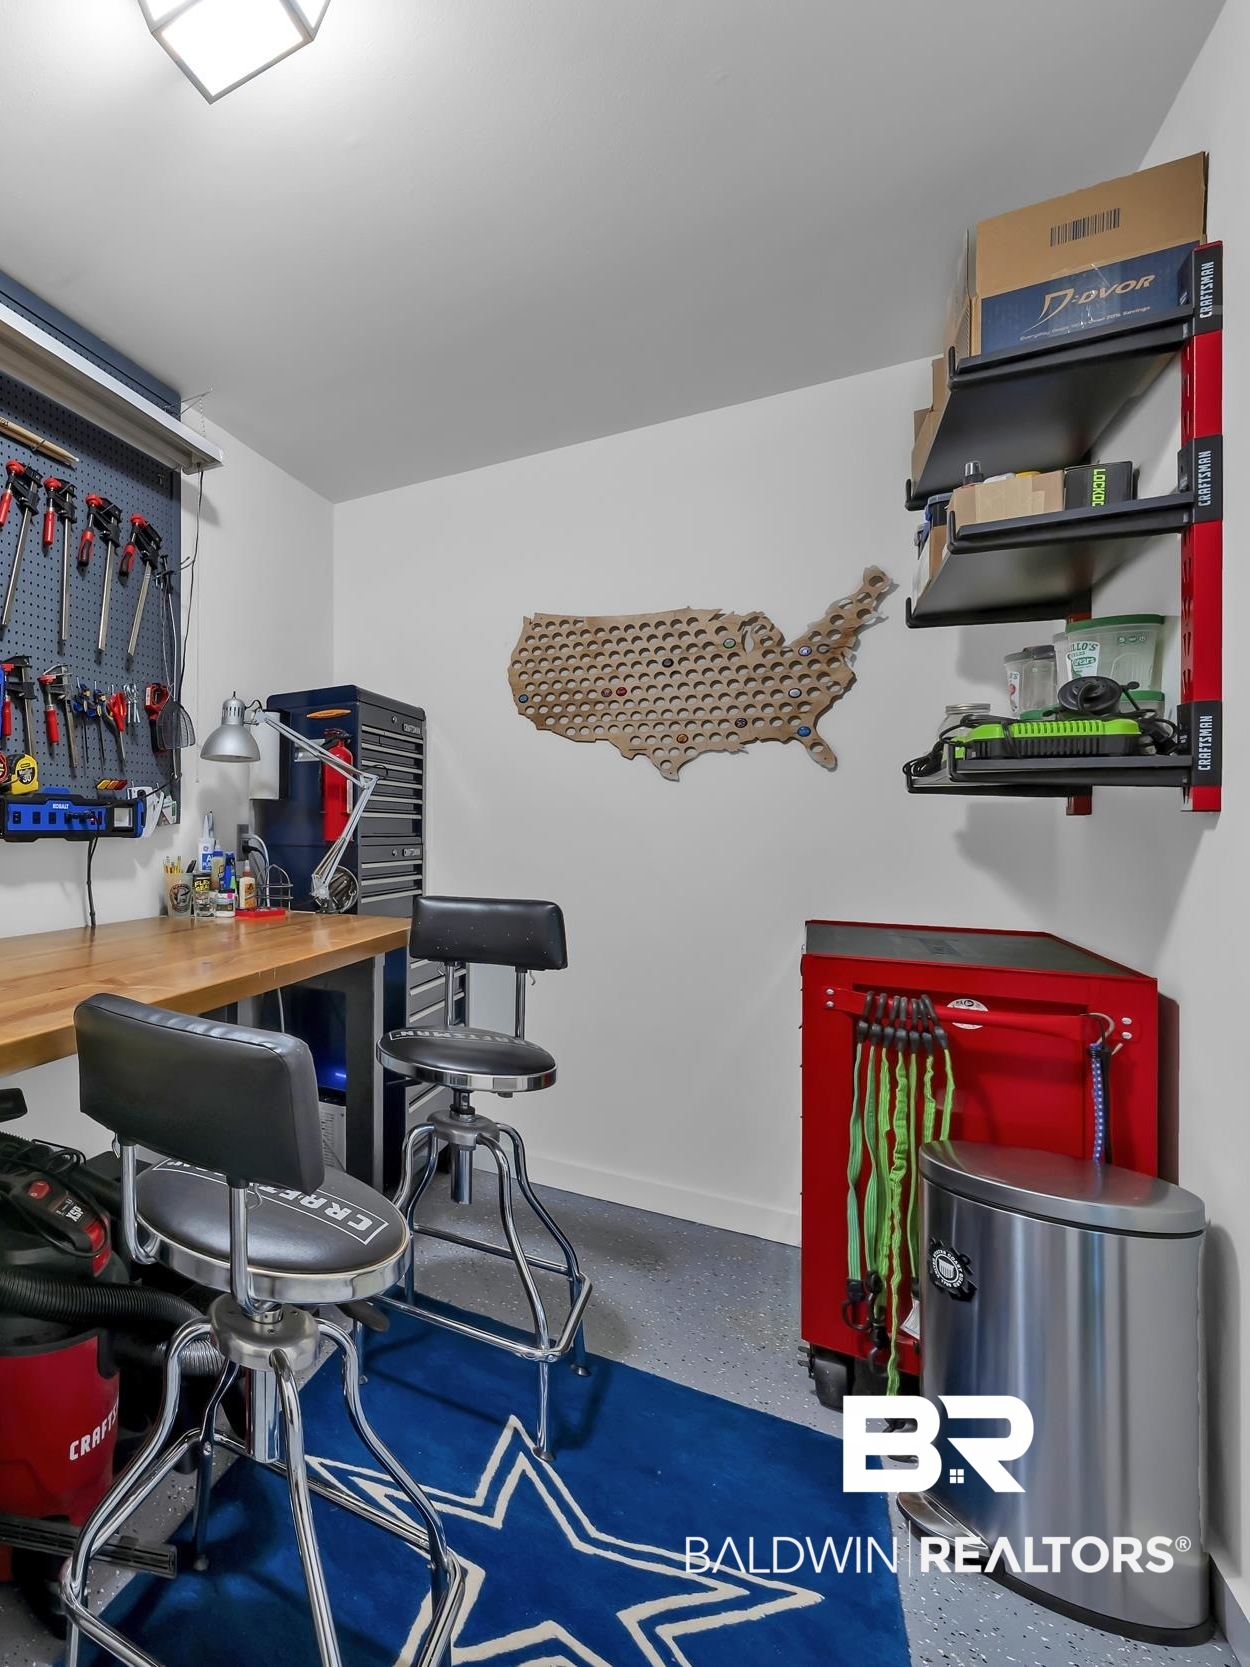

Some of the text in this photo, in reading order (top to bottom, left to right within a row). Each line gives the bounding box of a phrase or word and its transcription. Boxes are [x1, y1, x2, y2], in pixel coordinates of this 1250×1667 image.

[1199, 261, 1214, 318] CRAFTSMAN
[1197, 450, 1212, 507] CRAFTSMAN
[1197, 715, 1213, 770] CRAFTSMAN
